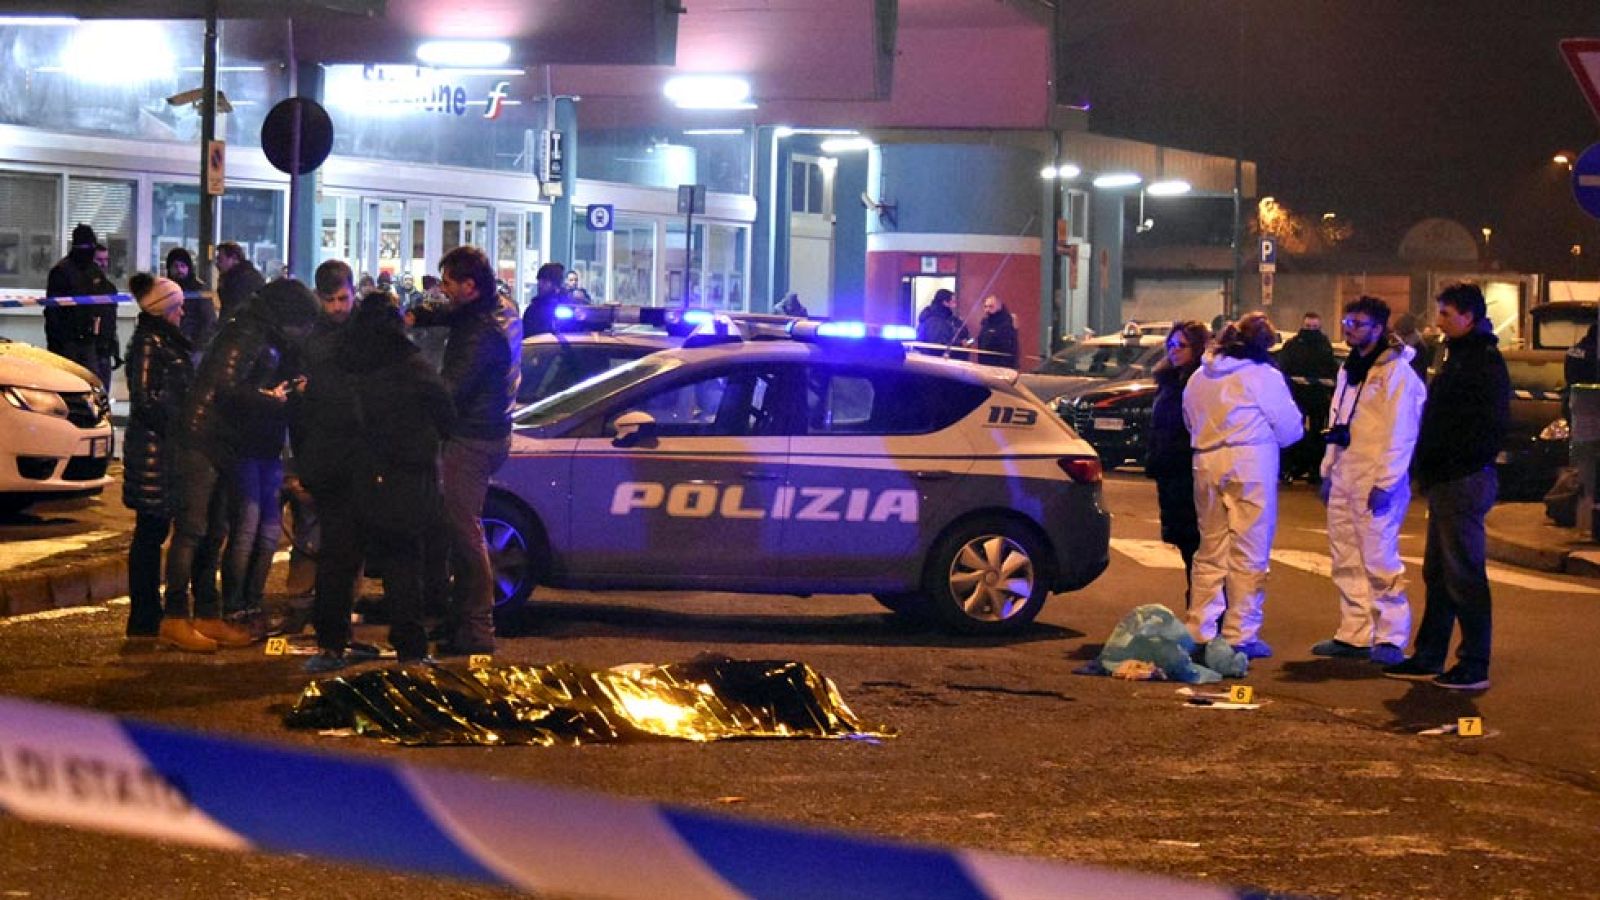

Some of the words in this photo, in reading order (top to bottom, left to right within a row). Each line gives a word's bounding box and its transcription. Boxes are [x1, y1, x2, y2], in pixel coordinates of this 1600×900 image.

[1262, 241, 1273, 261] P
[988, 406, 1038, 426] 113
[610, 481, 919, 524] POLIZIA
[1236, 687, 1245, 700] 6
[1464, 719, 1474, 732] 7
